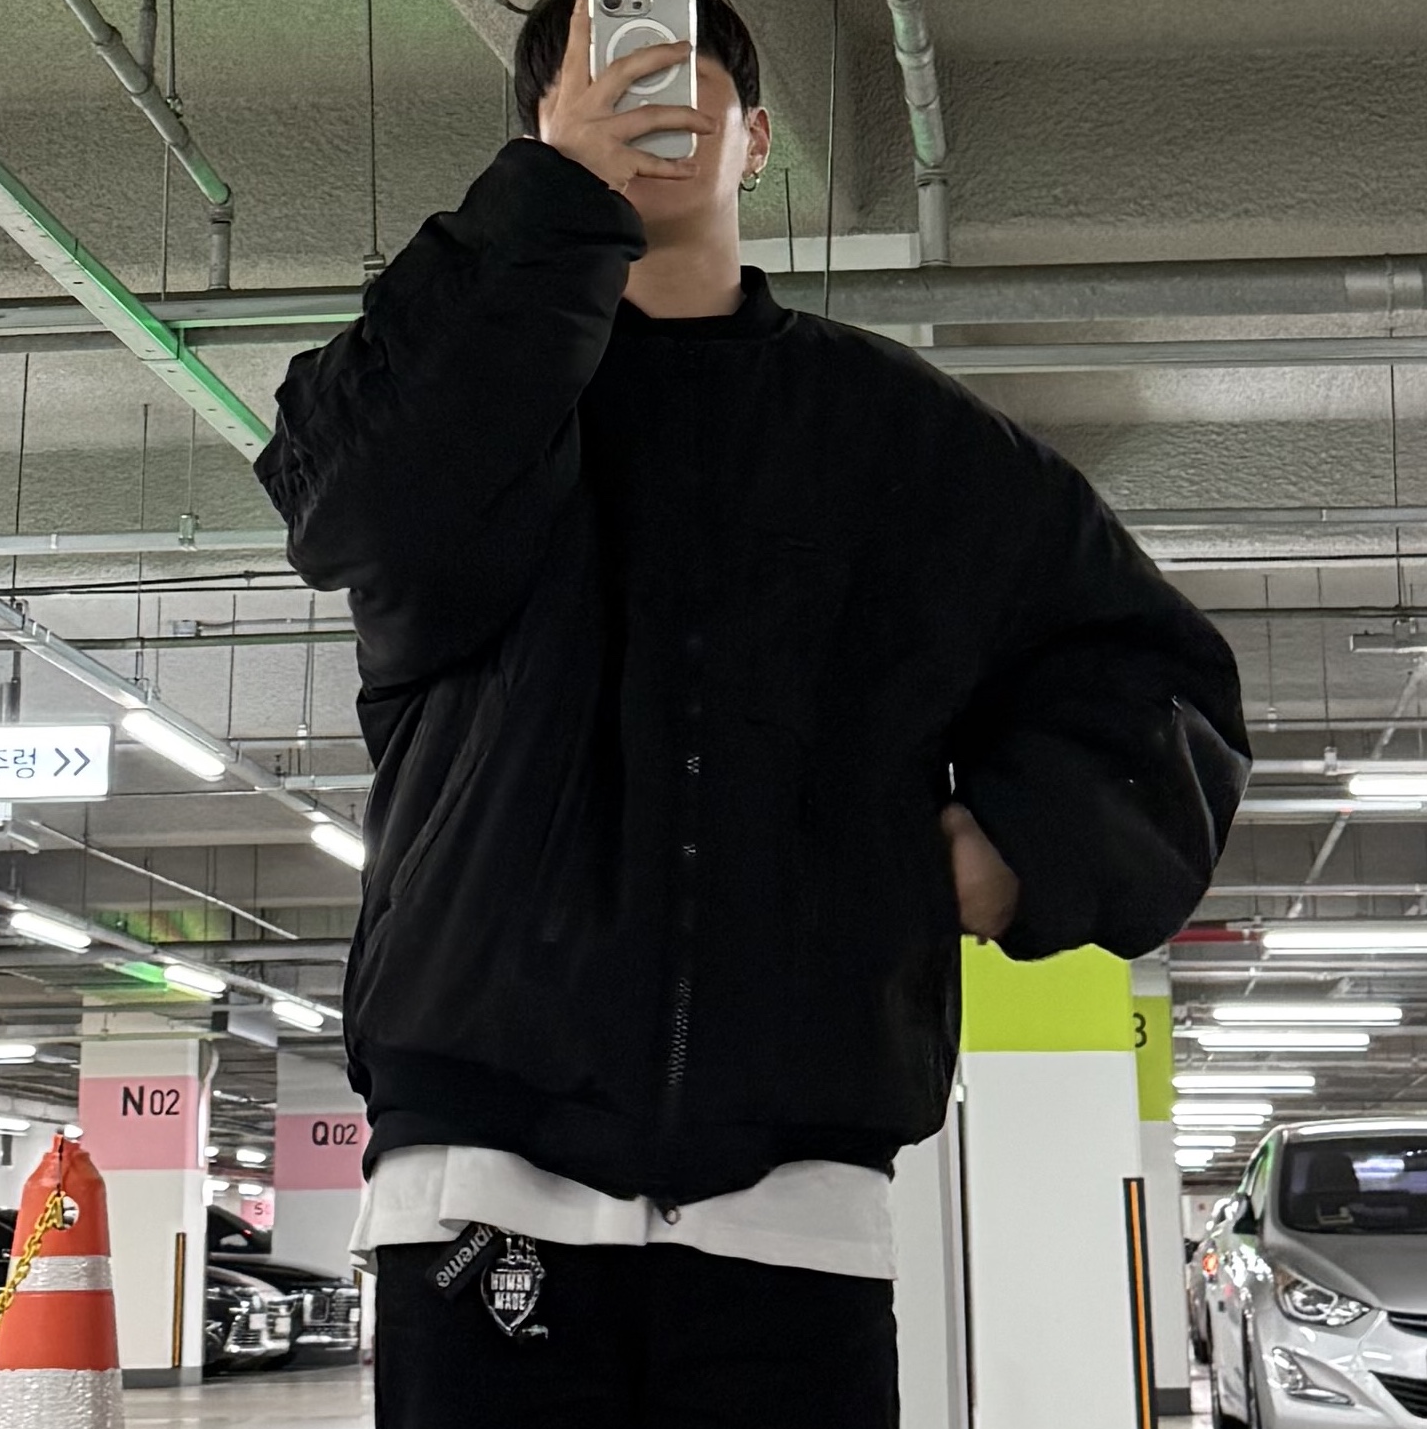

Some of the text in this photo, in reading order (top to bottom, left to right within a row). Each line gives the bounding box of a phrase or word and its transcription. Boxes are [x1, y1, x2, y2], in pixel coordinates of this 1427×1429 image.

[1133, 1012, 1147, 1048] 3
[122, 1086, 180, 1116] N 02
[312, 1121, 358, 1145] Q 02
[494, 1292, 527, 1311] MADE
